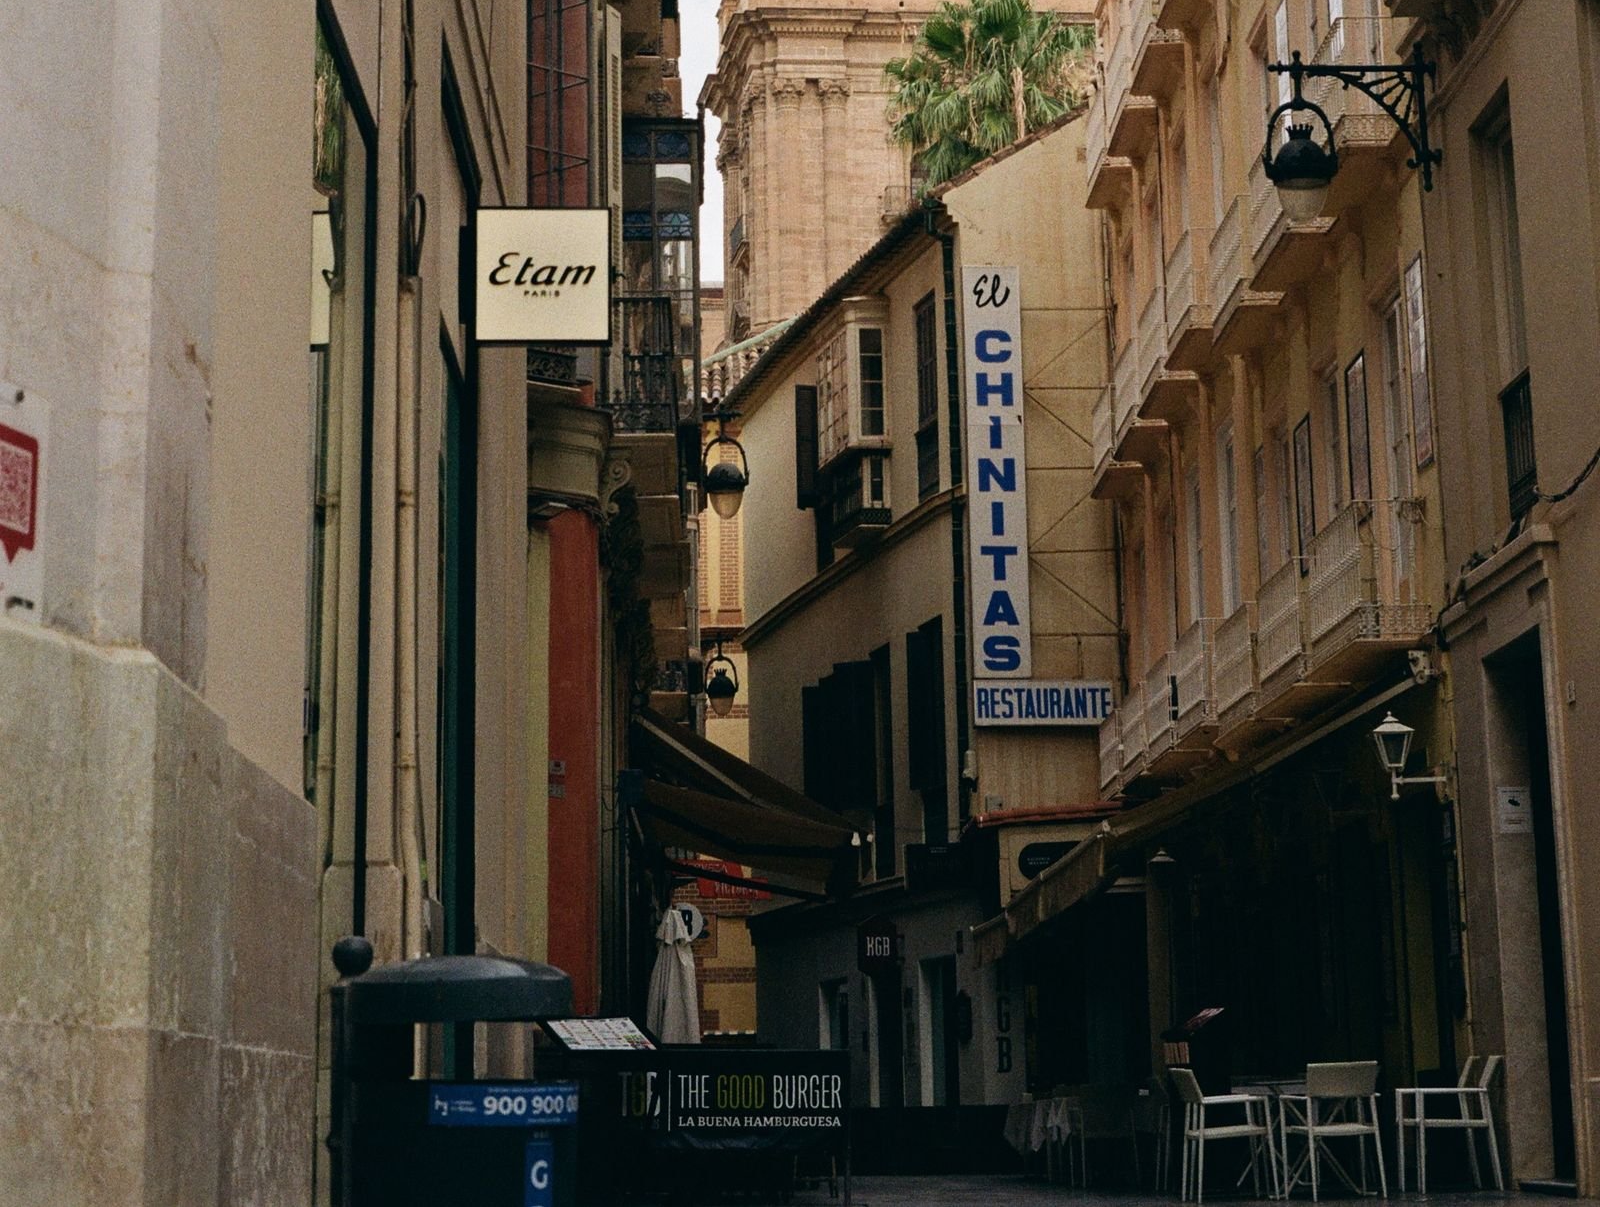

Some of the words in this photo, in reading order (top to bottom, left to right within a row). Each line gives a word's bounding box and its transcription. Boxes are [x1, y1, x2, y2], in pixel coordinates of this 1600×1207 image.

[488, 251, 597, 287] Etam
[523, 289, 561, 298] PARIS
[972, 273, 1010, 308] El
[974, 329, 1021, 673] CHINITAS
[976, 686, 1112, 722] RESTAURANTE
[865, 935, 890, 958] KGB
[483, 1095, 528, 1116] 900
[531, 1095, 564, 1115] 900
[677, 1074, 710, 1110] THE
[716, 1074, 765, 1110] GOOD
[772, 1074, 842, 1110] BURGER
[678, 1115, 696, 1128] LA
[697, 1115, 740, 1128] BUENA
[743, 1115, 842, 1129] HAMBURGUESA
